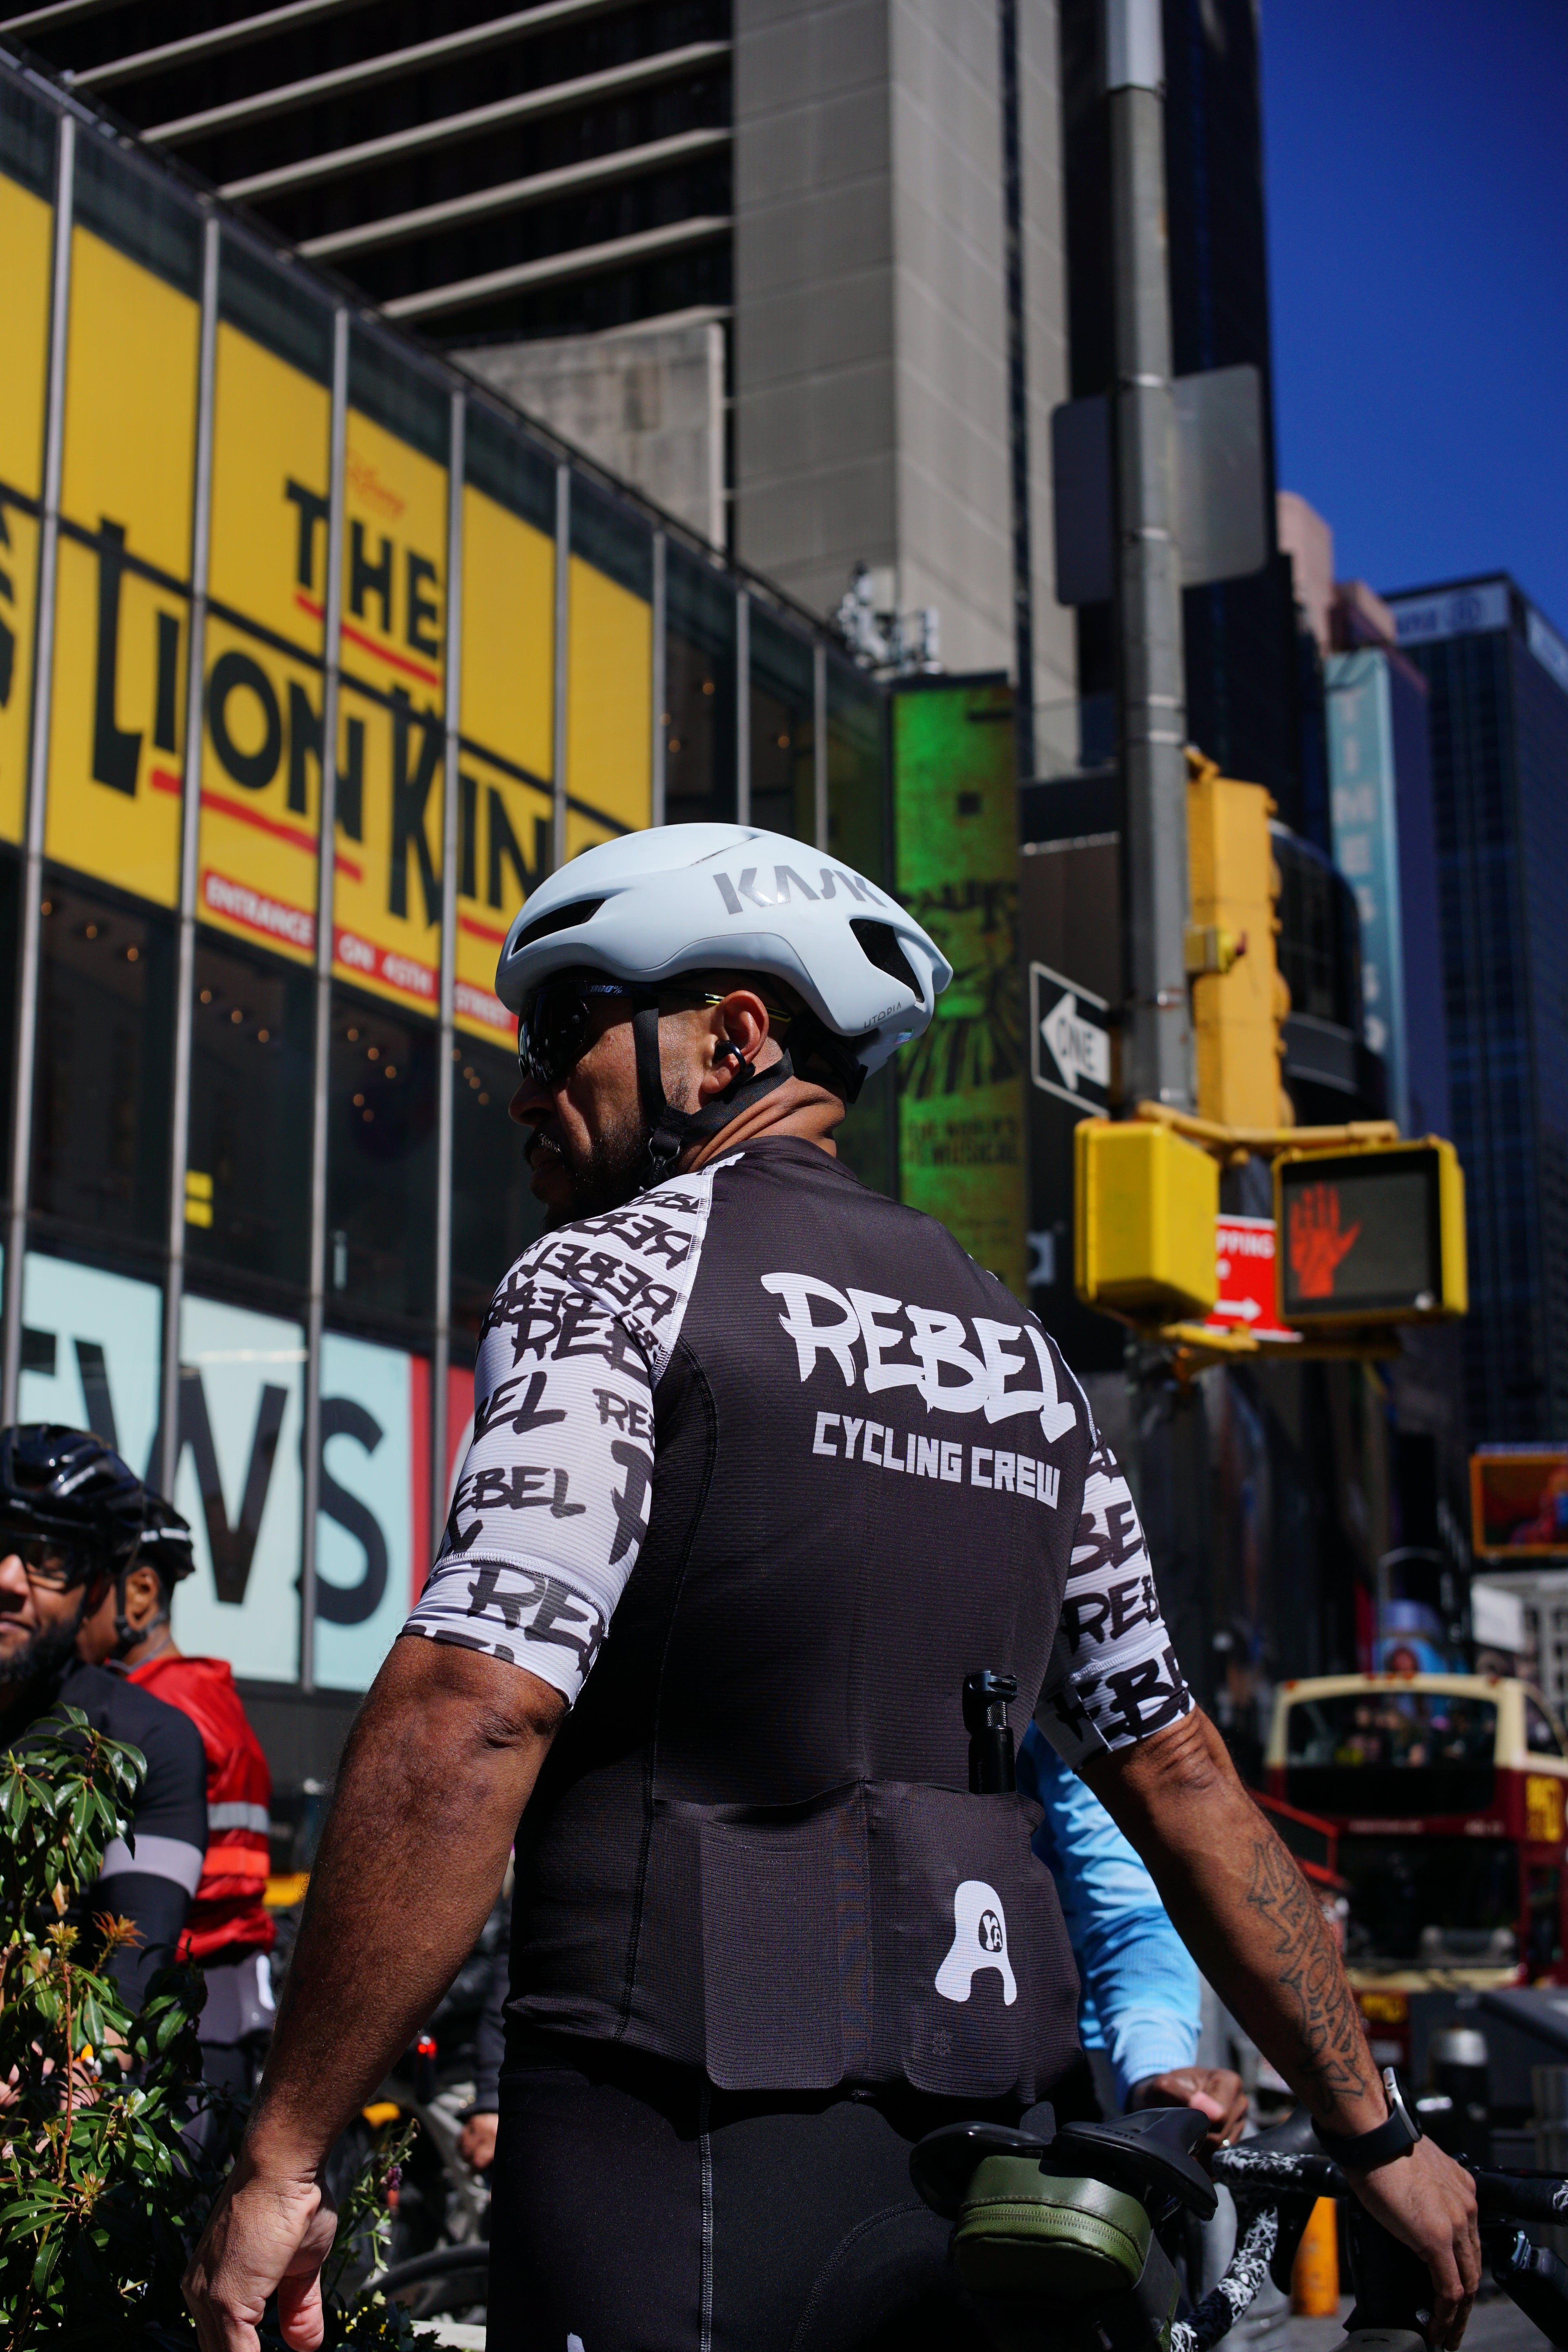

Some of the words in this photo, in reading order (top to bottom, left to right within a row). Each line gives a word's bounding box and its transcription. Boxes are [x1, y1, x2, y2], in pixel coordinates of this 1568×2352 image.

[285, 476, 439, 661] THE
[91, 514, 363, 844] LION
[389, 685, 602, 929] KIN
[205, 876, 314, 946] ENTRANCE
[339, 934, 375, 973] ON
[454, 983, 511, 1031] STREET
[713, 865, 888, 915] KASK
[864, 1002, 901, 1028] UTOPIA
[1056, 1015, 1095, 1072] ONE
[592, 1388, 655, 1450] RE
[760, 1272, 1077, 1444] REBEL
[21, 1325, 388, 1625] WS
[813, 1411, 962, 1483] CYCLING
[971, 1446, 1060, 1510] CREW
